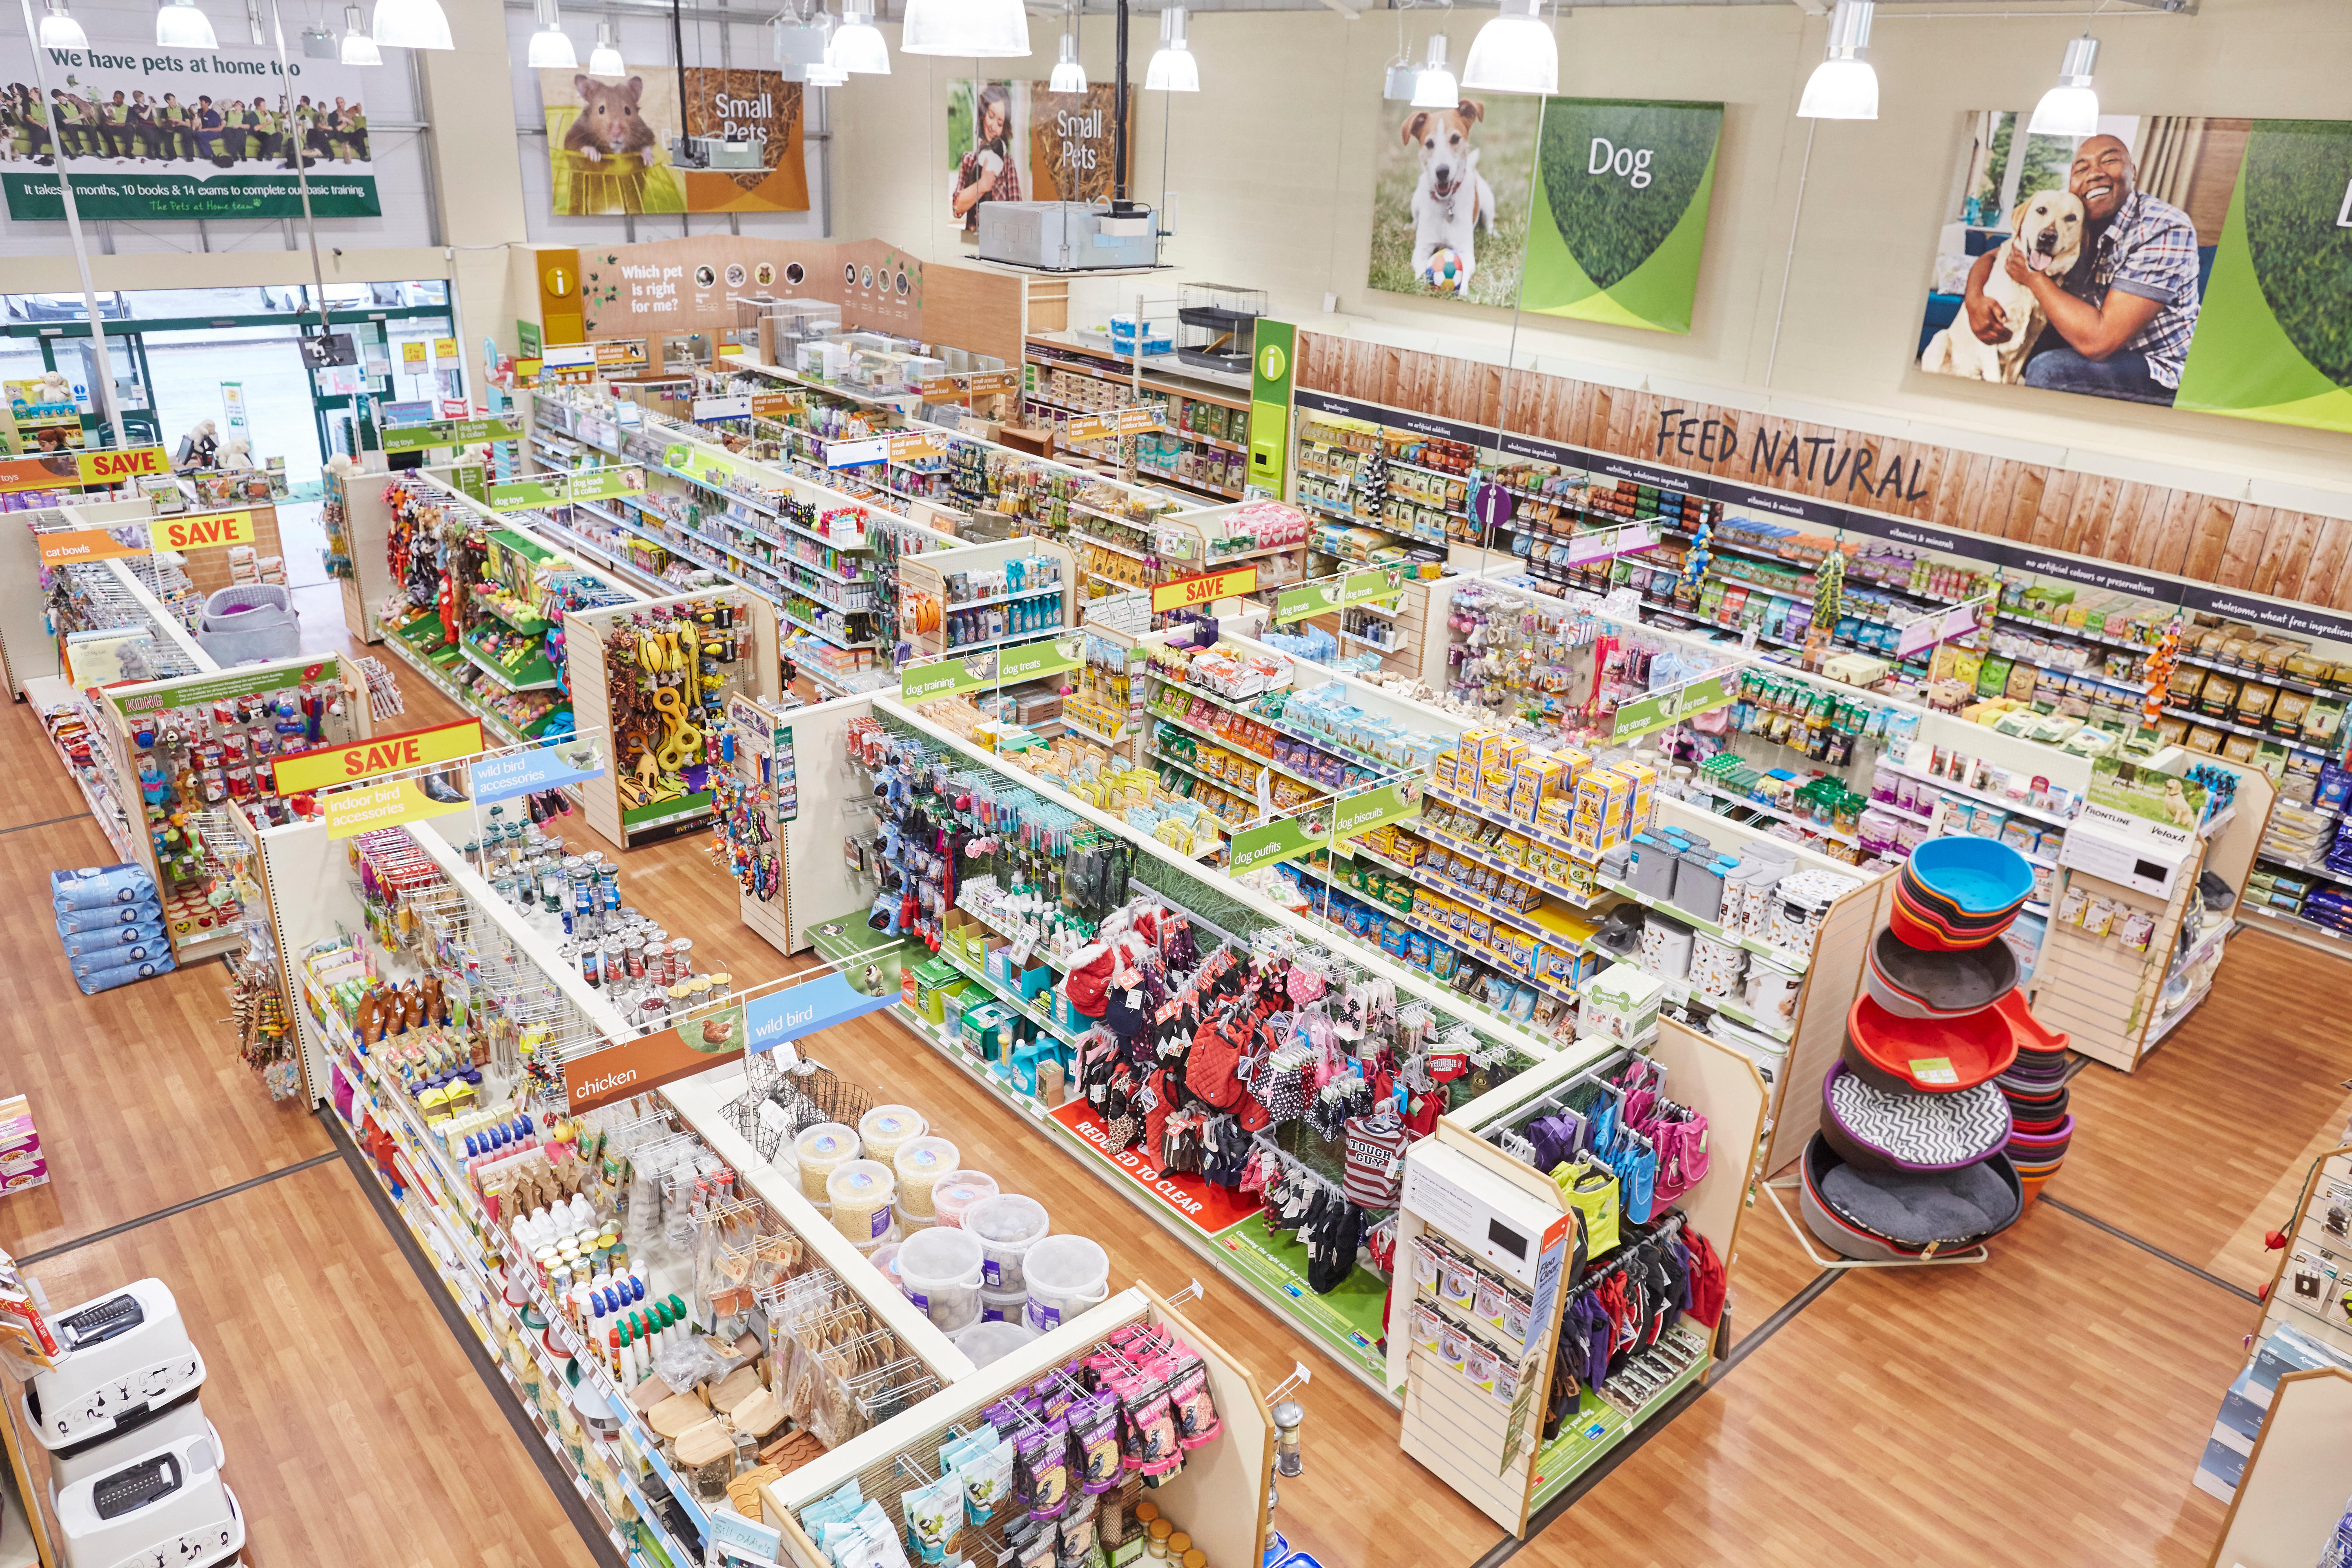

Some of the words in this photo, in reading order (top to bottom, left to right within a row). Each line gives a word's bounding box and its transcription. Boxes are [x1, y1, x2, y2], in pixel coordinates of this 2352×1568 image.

[48, 48, 82, 66] We
[87, 49, 136, 69] have
[143, 56, 183, 75] pets
[190, 57, 209, 73] at
[212, 56, 265, 75] home
[715, 93, 772, 119] Small
[1057, 109, 1102, 139] Small
[724, 121, 767, 146] Pets
[1063, 141, 1096, 170] Pets
[1588, 138, 1654, 189] Dog
[24, 184, 31, 195] It
[35, 184, 62, 195] takes
[76, 184, 119, 196] months,
[121, 185, 134, 195] 10
[137, 185, 169, 196] books
[172, 185, 181, 195] &
[183, 185, 195, 195] 14
[198, 186, 229, 195] exams
[231, 186, 241, 195] to
[243, 185, 286, 198] complete
[306, 185, 329, 195] basic
[331, 185, 365, 197] training
[149, 201, 163, 211] The
[170, 201, 189, 211] Pets
[207, 200, 229, 210] Home
[232, 201, 254, 210] team
[621, 265, 660, 279] Which
[663, 265, 683, 281] pet
[632, 283, 643, 296] is
[646, 281, 676, 298] right
[631, 299, 650, 313] for
[653, 298, 678, 312] me?
[387, 440, 400, 448] dog
[906, 438, 922, 446] animal
[94, 452, 156, 475] SAVE
[1657, 409, 1737, 463] FEED
[1750, 427, 1928, 502] NATURAL
[1, 474, 19, 482] toys
[573, 479, 586, 488] dog
[587, 477, 604, 485] leads
[1634, 471, 1659, 482] wholesome
[1661, 476, 1688, 489] ingredients
[581, 486, 601, 495] collars
[495, 497, 508, 506] dog
[510, 496, 524, 505] toys
[1748, 496, 1771, 508] vitamins
[1779, 504, 1803, 515] minerals
[168, 518, 239, 546] SAVE
[1890, 528, 1917, 541] vitamins
[1925, 537, 1954, 550] minerals
[46, 549, 60, 557] cat
[62, 544, 90, 555] bowls
[2037, 561, 2069, 574] artificial
[2070, 569, 2094, 581] colours
[2106, 578, 2154, 595] preservatives
[1186, 577, 1223, 601] SAVE
[1346, 590, 1356, 599] dog
[1358, 587, 1372, 598] treats
[1281, 606, 1293, 616] dog
[1294, 602, 1309, 613] treats
[2212, 600, 2257, 619] wholesome,
[2261, 610, 2287, 623] wheat
[2289, 616, 2306, 628] free
[1003, 664, 1018, 675] dog
[1020, 659, 1040, 671] treats
[906, 684, 923, 695] dog
[924, 677, 955, 691] training
[125, 694, 163, 712] KONG
[1682, 702, 1692, 712] dog
[1693, 696, 1708, 707] treats
[1617, 722, 1629, 734] dog
[1630, 716, 1650, 730] storage
[344, 739, 421, 775] SAVE
[478, 763, 499, 779] wild
[501, 758, 525, 773] bird
[480, 771, 545, 793] accessories
[330, 794, 372, 812] indoor
[375, 787, 400, 802] bird
[332, 804, 405, 827] accessories
[1337, 817, 1353, 831] dog
[1354, 807, 1383, 823] biscuits
[2085, 806, 2130, 826] FRONTLINE
[2152, 826, 2185, 843] VeloxA
[1234, 851, 1252, 865] dog
[1254, 841, 1281, 859] outfits
[1335, 842, 1346, 850] FOR
[1119, 976, 1134, 987] £7
[1128, 969, 1140, 981] NOW
[1596, 993, 1624, 1004] wag-a-tude
[755, 1015, 783, 1037] wild
[786, 1004, 813, 1026] bird
[576, 1069, 637, 1098] chicken
[1395, 1082, 1406, 1093] NEW
[1168, 1125, 1180, 1134] £3
[1176, 1119, 1187, 1128] NOW
[1350, 1139, 1392, 1160] TOUGH
[1075, 1121, 1139, 1166] REDUED
[1136, 1164, 1158, 1182] TO
[1156, 1179, 1203, 1215] CLEAR
[1356, 1154, 1383, 1169] GUY
[1236, 1230, 1260, 1250] Choosing
[1258, 1245, 1267, 1257] the
[1266, 1252, 1280, 1266] right
[1278, 1261, 1290, 1272] size
[1288, 1268, 1298, 1278] for
[1296, 1275, 1311, 1288] your
[1539, 1257, 1555, 1273] Flea
[1540, 1265, 1557, 1283] Clear
[39, 1326, 48, 1339] Care
[1171, 1387, 1184, 1400] SUET
[1185, 1368, 1205, 1391] PELLETS
[1044, 1397, 1057, 1411] SUET
[1176, 1392, 1192, 1403] BERRY
[1047, 1400, 1065, 1415] INSECT
[1137, 1409, 1150, 1422] SUET
[1150, 1393, 1170, 1416] PELLETS
[1561, 1424, 1572, 1434] for
[1572, 1415, 1583, 1428] your
[1580, 1408, 1595, 1420] dog
[1083, 1433, 1097, 1447] SUET
[1097, 1417, 1117, 1439] PELLETS
[1087, 1436, 1108, 1451] INSECT
[1032, 1459, 1046, 1474] SUET
[1046, 1445, 1067, 1466] PELLETS
[1036, 1463, 1056, 1479] INSECT
[946, 1514, 954, 1522] wild
[1062, 1517, 1076, 1530] SUET
[1076, 1504, 1096, 1523] PELLETS
[713, 1524, 732, 1537] Bill
[736, 1534, 771, 1553] Oddie's
[1021, 1547, 1036, 1563] SUET
[1036, 1534, 1056, 1554] PELLETS
